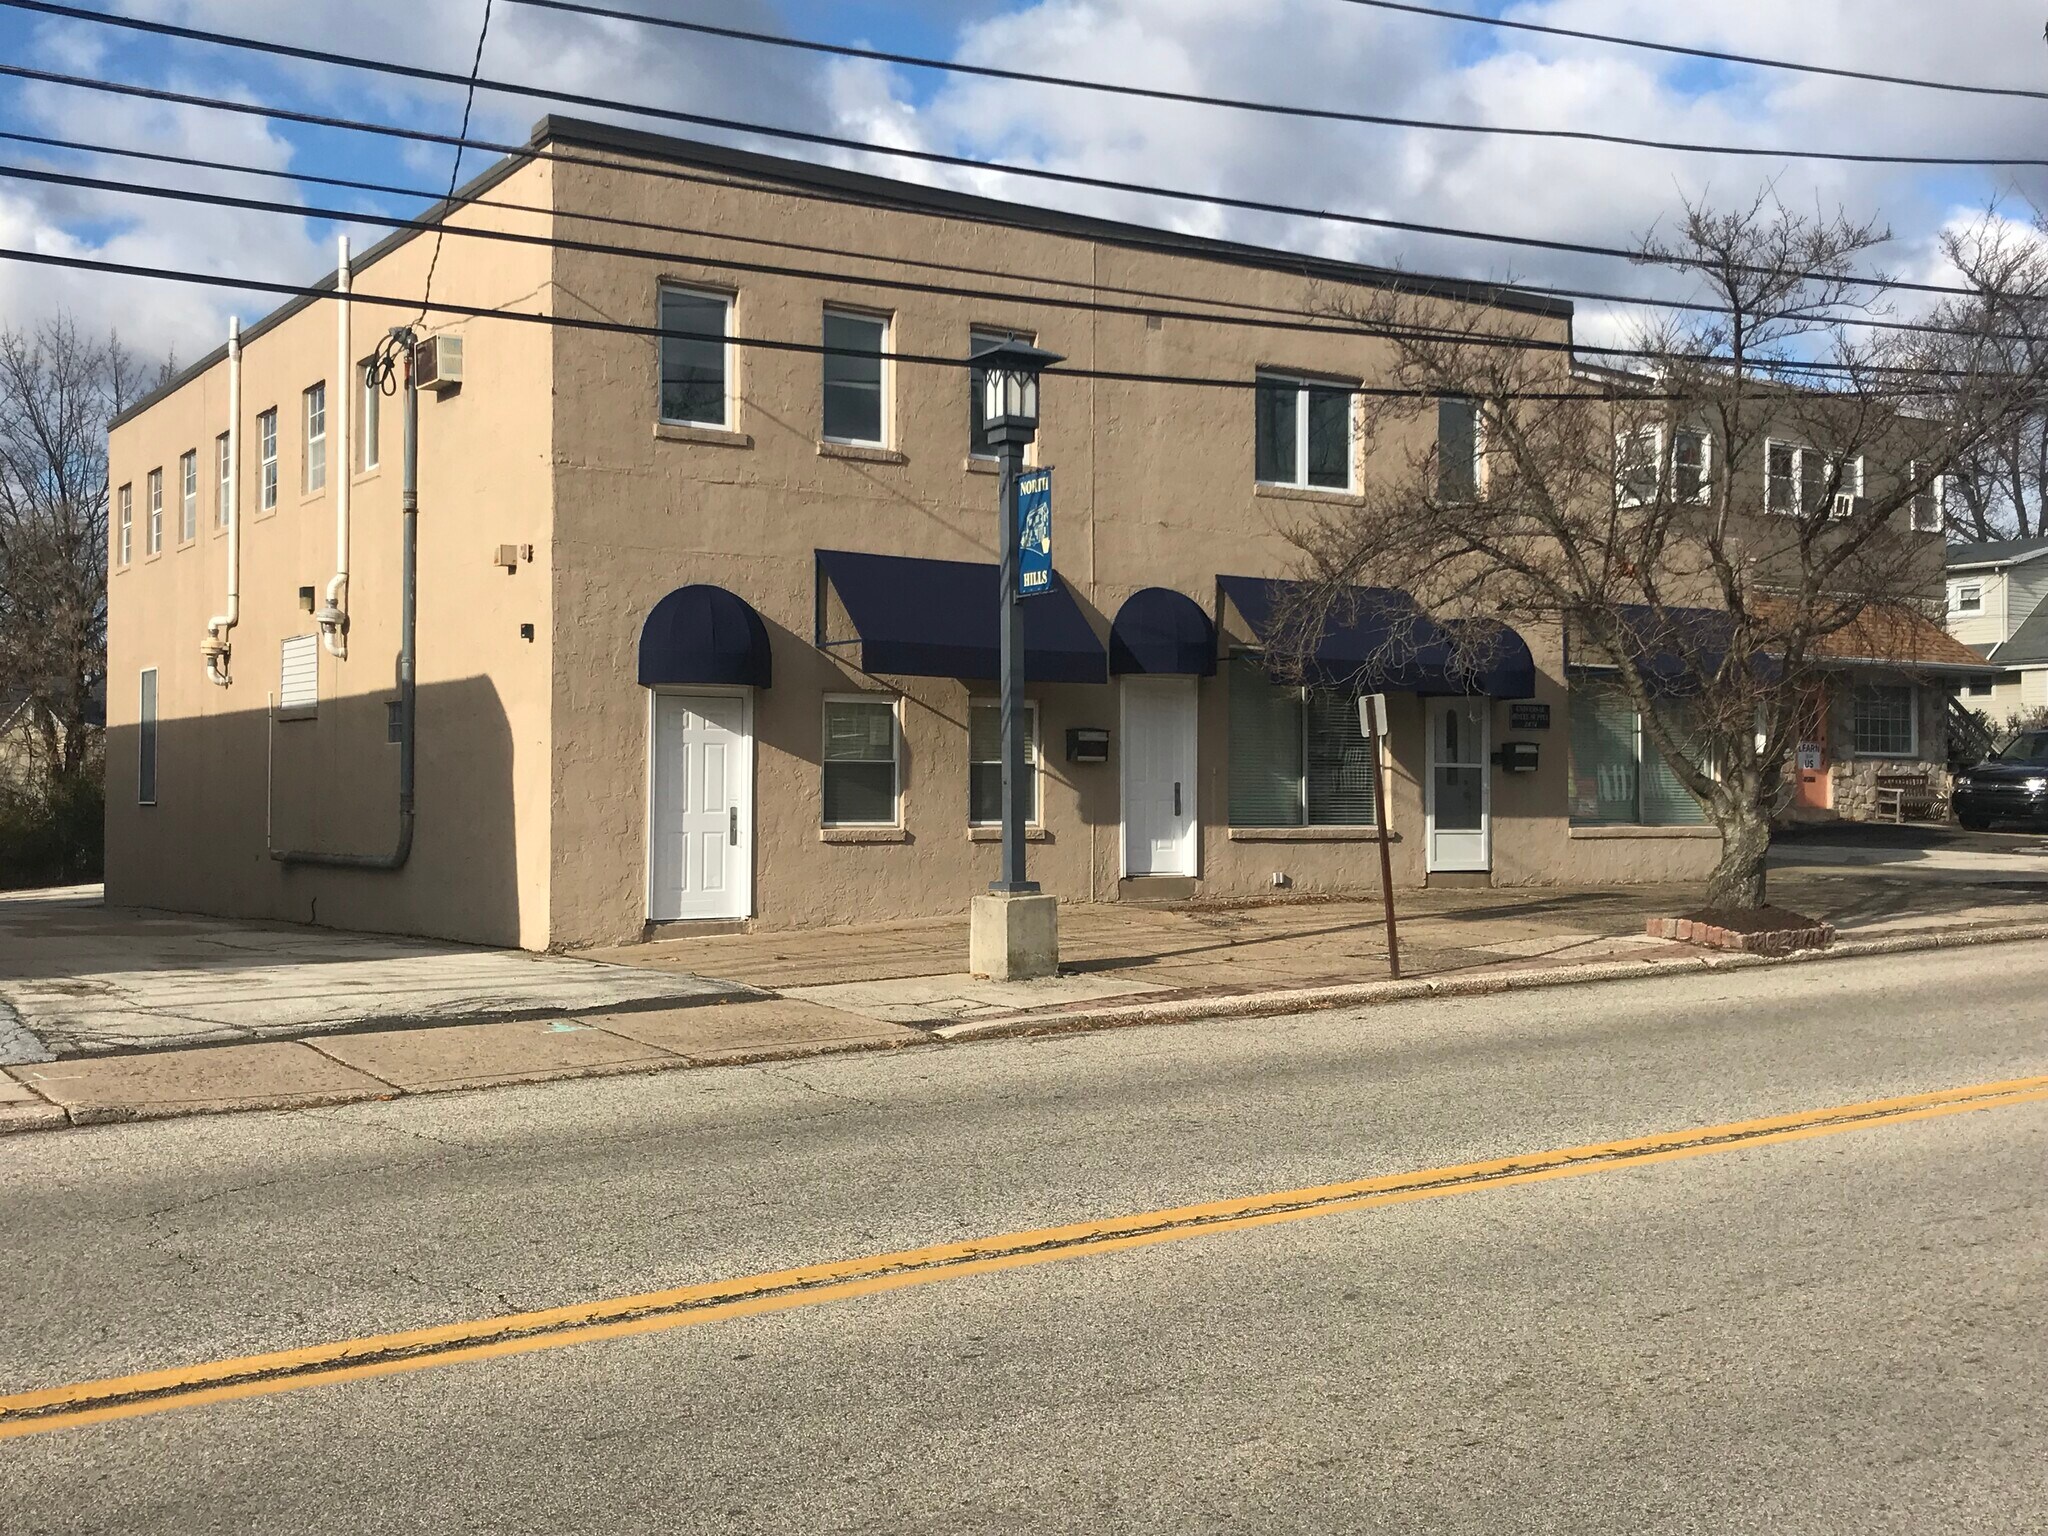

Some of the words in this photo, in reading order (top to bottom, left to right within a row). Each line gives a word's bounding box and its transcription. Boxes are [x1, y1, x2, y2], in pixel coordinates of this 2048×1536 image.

[1020, 477, 1048, 496] NORTH
[1023, 570, 1048, 587] HILLS
[1798, 743, 1820, 753] LEARN
[1804, 759, 1814, 769] US
